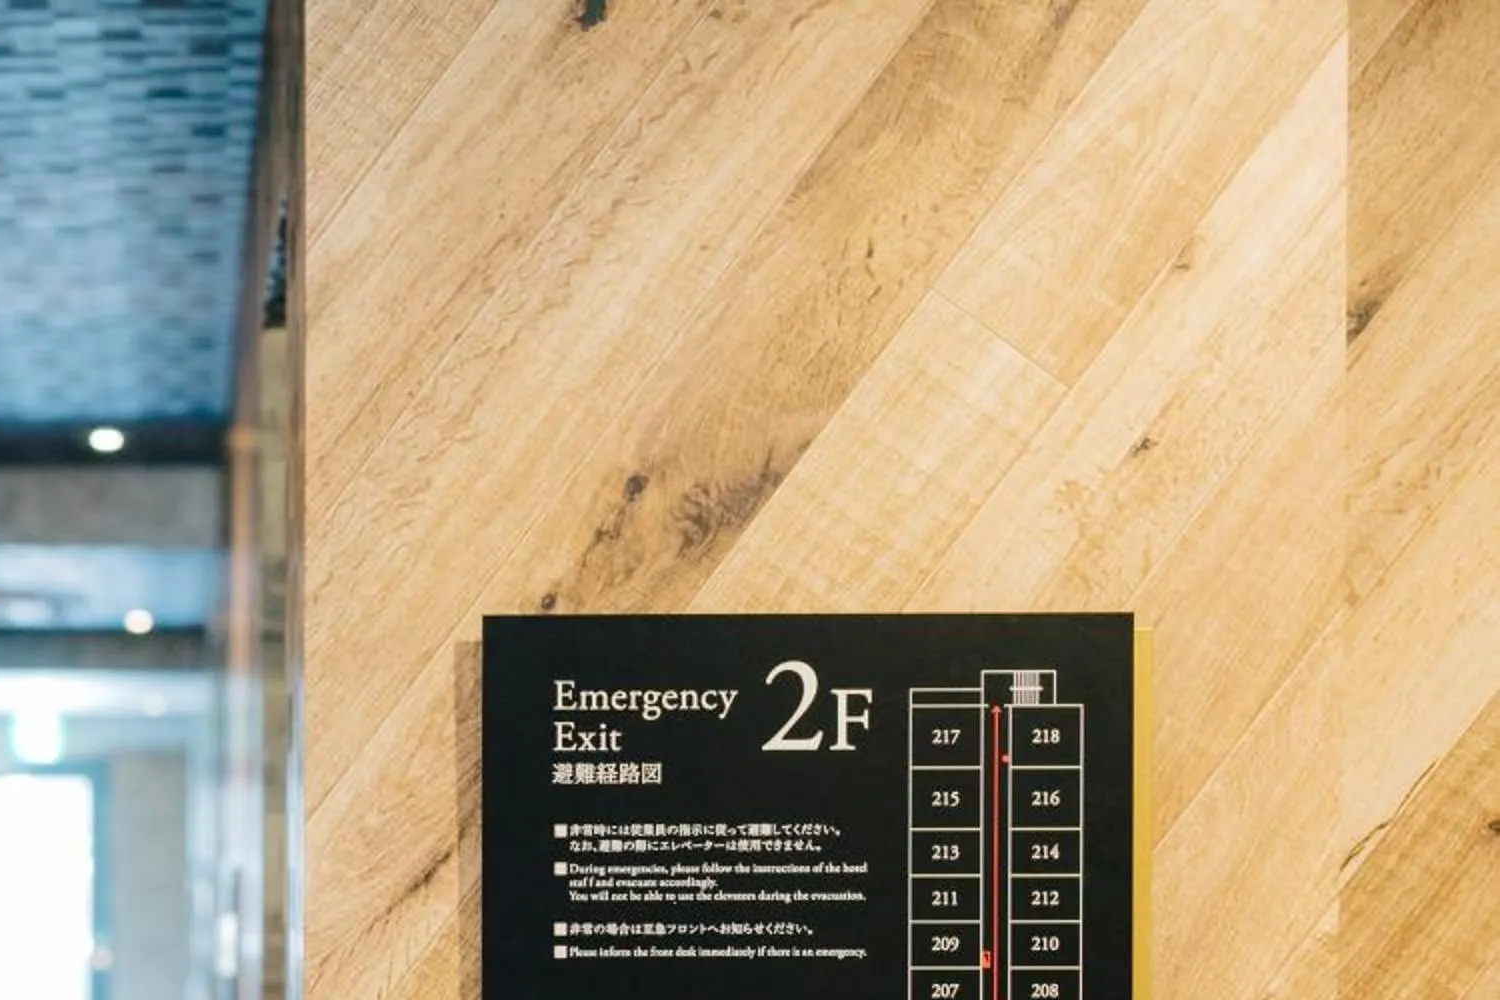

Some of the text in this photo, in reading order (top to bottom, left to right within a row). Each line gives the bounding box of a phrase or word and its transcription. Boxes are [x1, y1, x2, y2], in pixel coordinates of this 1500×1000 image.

[554, 680, 738, 720] Emergency
[762, 660, 872, 751] 2F
[553, 721, 622, 751] Exit
[932, 729, 961, 744] 217
[1032, 728, 1060, 744] 218
[552, 763, 662, 784] 避難経路図
[932, 791, 960, 807] 215
[1032, 790, 1060, 806] 216
[932, 845, 960, 860] 213
[1032, 843, 1059, 859] 214
[570, 863, 606, 876] During
[670, 863, 700, 876] please
[702, 862, 732, 873] follow
[734, 862, 750, 873] the
[752, 864, 811, 873] instructions
[812, 862, 824, 873] of
[825, 862, 841, 873] the
[843, 862, 868, 873] hotel
[595, 877, 614, 887] and
[569, 891, 588, 901] You
[590, 890, 609, 901] will
[611, 893, 628, 901] not
[630, 890, 642, 901] be
[644, 890, 663, 901] able
[696, 890, 712, 900] the
[714, 890, 756, 900] elevators
[758, 890, 792, 904] during
[793, 890, 809, 900] the
[811, 890, 866, 900] evacuation.
[932, 891, 957, 906] 211
[1031, 890, 1059, 905] 212
[932, 936, 960, 952] 209
[1031, 936, 1059, 951] 210
[570, 946, 597, 957] Please
[599, 946, 631, 957] inform
[634, 946, 648, 957] the
[650, 946, 674, 957] front
[675, 946, 696, 957] desk
[698, 946, 756, 959] immediately
[758, 946, 766, 957] if
[767, 946, 790, 956] there
[792, 947, 800, 956] is
[815, 949, 867, 960] emergency.
[932, 983, 959, 998] 207
[1032, 983, 1059, 998] 208
